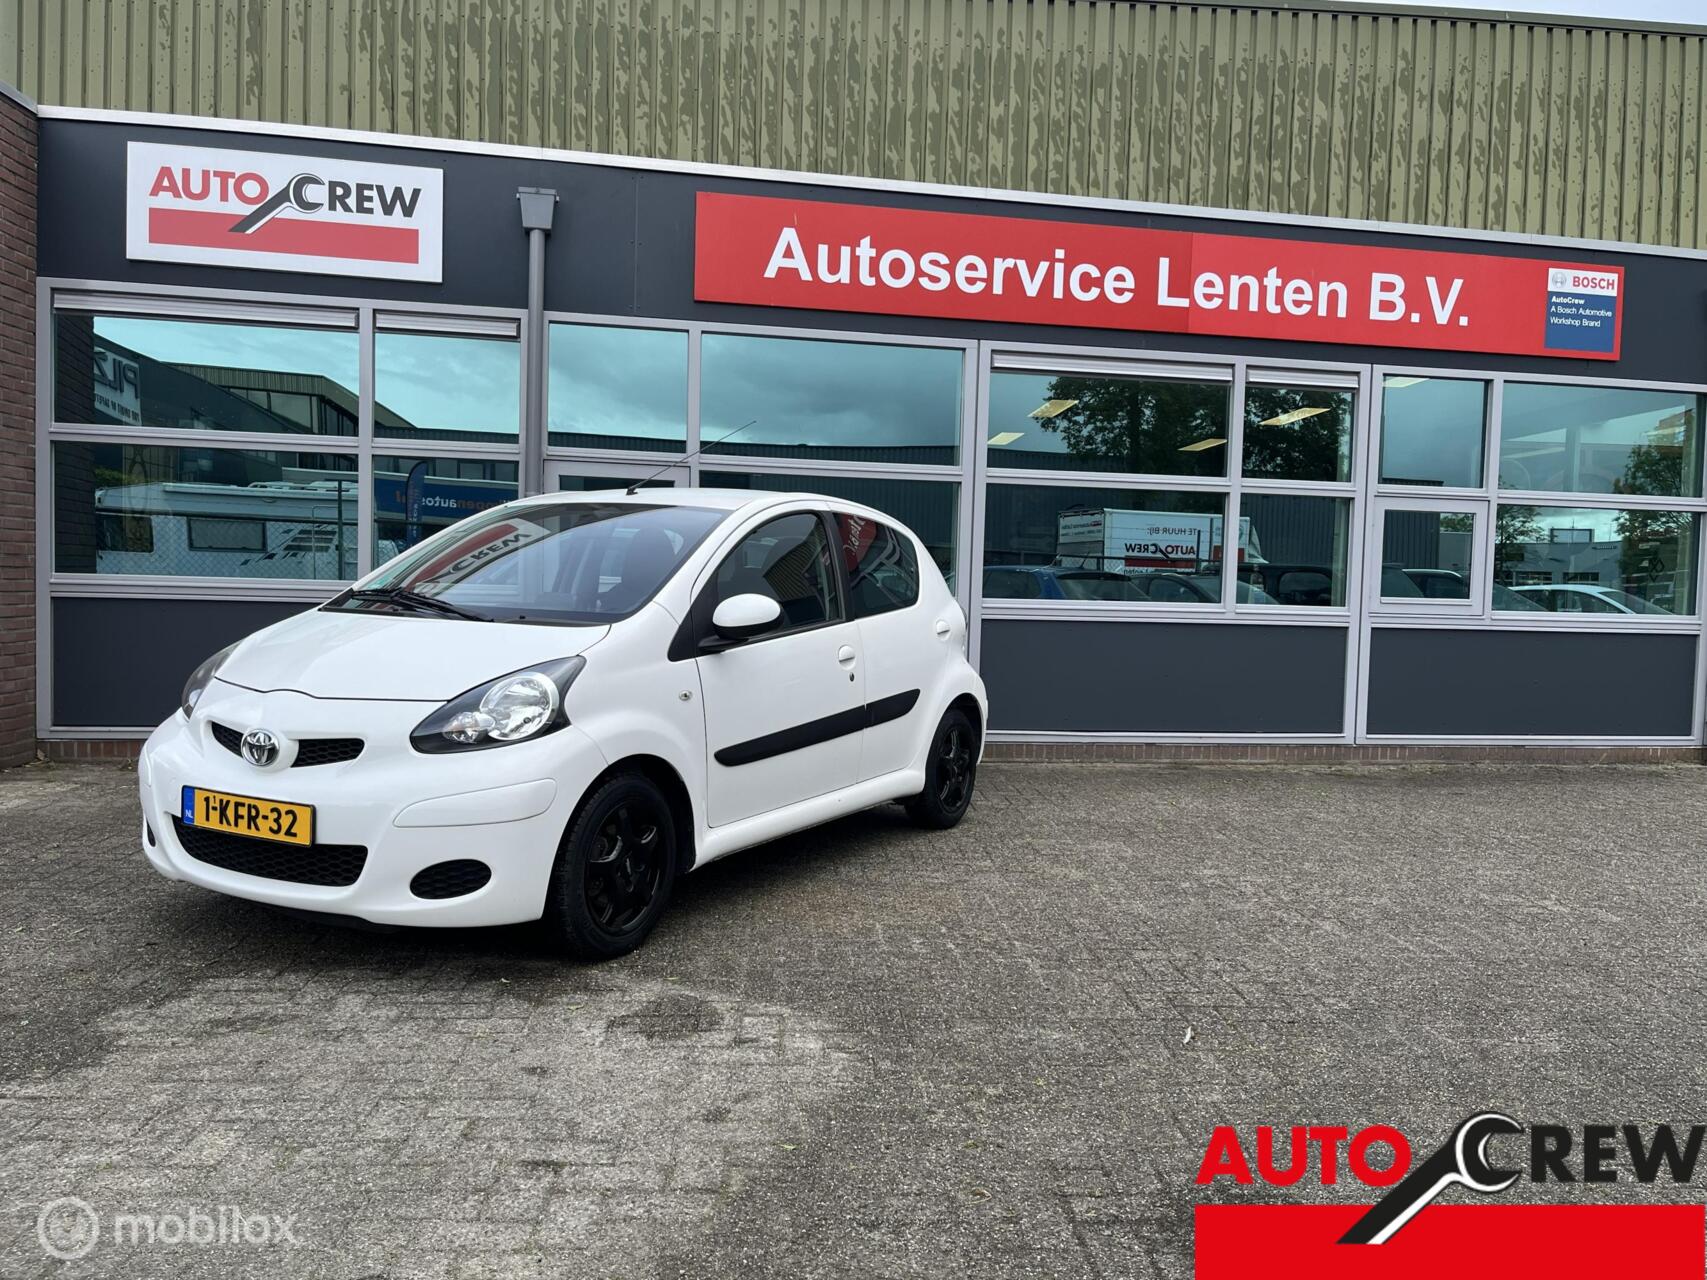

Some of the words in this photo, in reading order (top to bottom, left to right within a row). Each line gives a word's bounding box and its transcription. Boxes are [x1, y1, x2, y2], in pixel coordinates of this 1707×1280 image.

[148, 166, 269, 206] AUTO
[763, 227, 1135, 304] Autoservice
[1157, 257, 1348, 319] Lenten
[1369, 272, 1469, 327] B.V.
[1572, 276, 1615, 290] BOSCH
[1551, 295, 1585, 305] AutoCrew
[1550, 305, 1556, 313] A
[1557, 305, 1577, 314] Bosch
[1578, 307, 1613, 317] Automotive
[1550, 316, 1581, 327] Workshop
[1582, 318, 1601, 327] Brand
[185, 809, 194, 819] NL
[203, 796, 298, 838] 1-KFR-32
